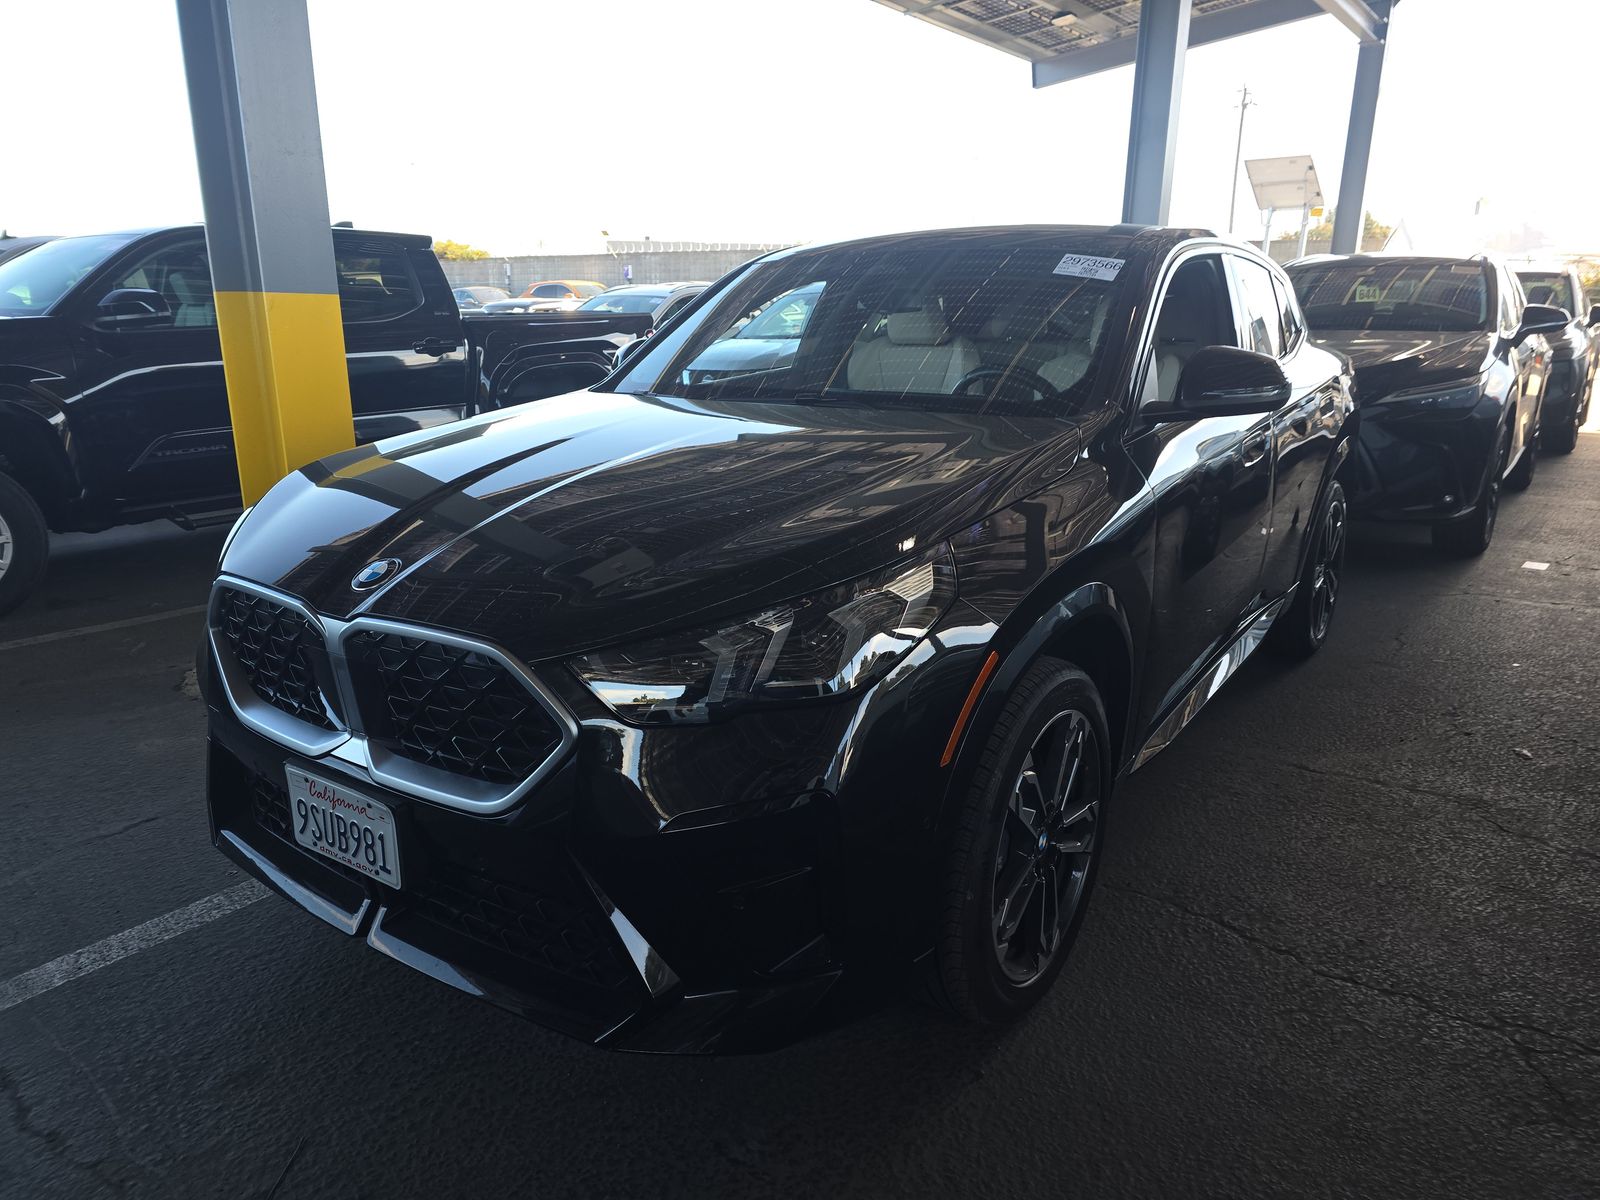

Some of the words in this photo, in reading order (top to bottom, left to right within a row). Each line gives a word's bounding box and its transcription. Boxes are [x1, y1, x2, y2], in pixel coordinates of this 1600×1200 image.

[1062, 256, 1122, 271] 2973566
[308, 780, 375, 820] California
[296, 798, 392, 875] 9SUB981
[319, 846, 374, 873] dmv.ca.gov
